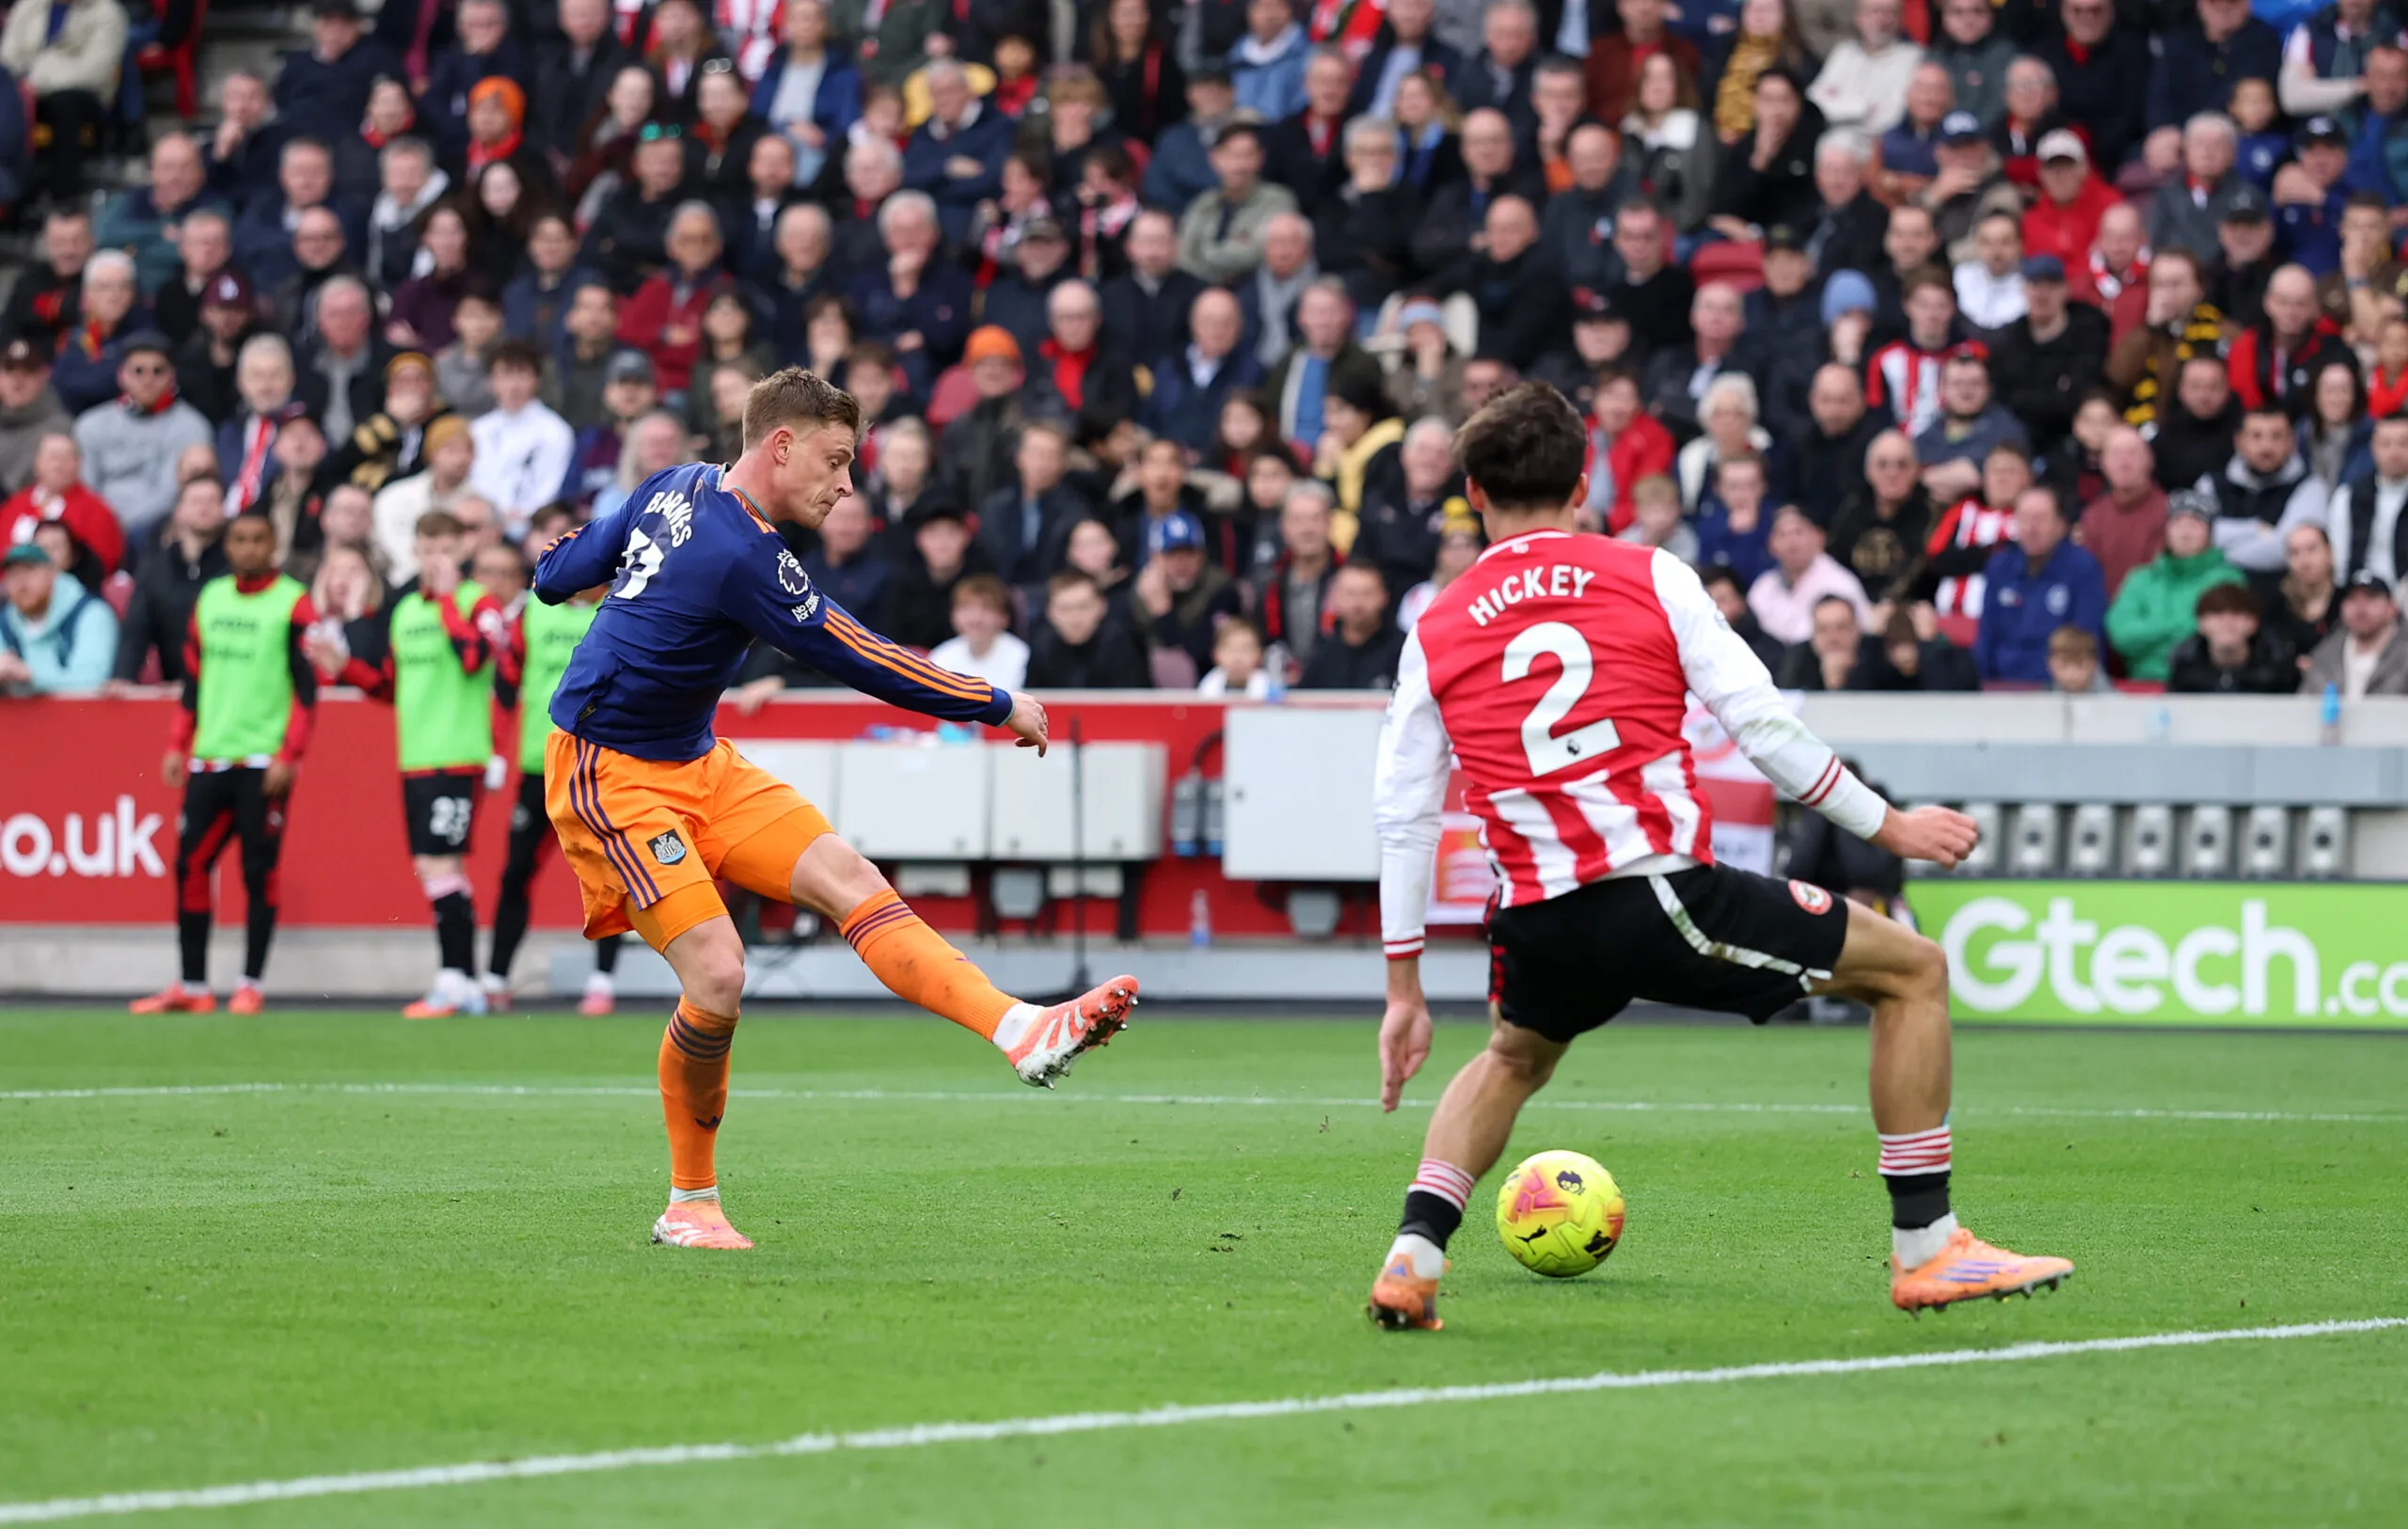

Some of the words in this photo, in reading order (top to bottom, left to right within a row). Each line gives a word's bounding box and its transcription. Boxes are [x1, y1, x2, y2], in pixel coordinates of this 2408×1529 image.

[643, 490, 692, 548] BARNES
[1467, 564, 1595, 627] HICKEY
[1501, 621, 1622, 778] 2
[0, 794, 166, 878] o.uk
